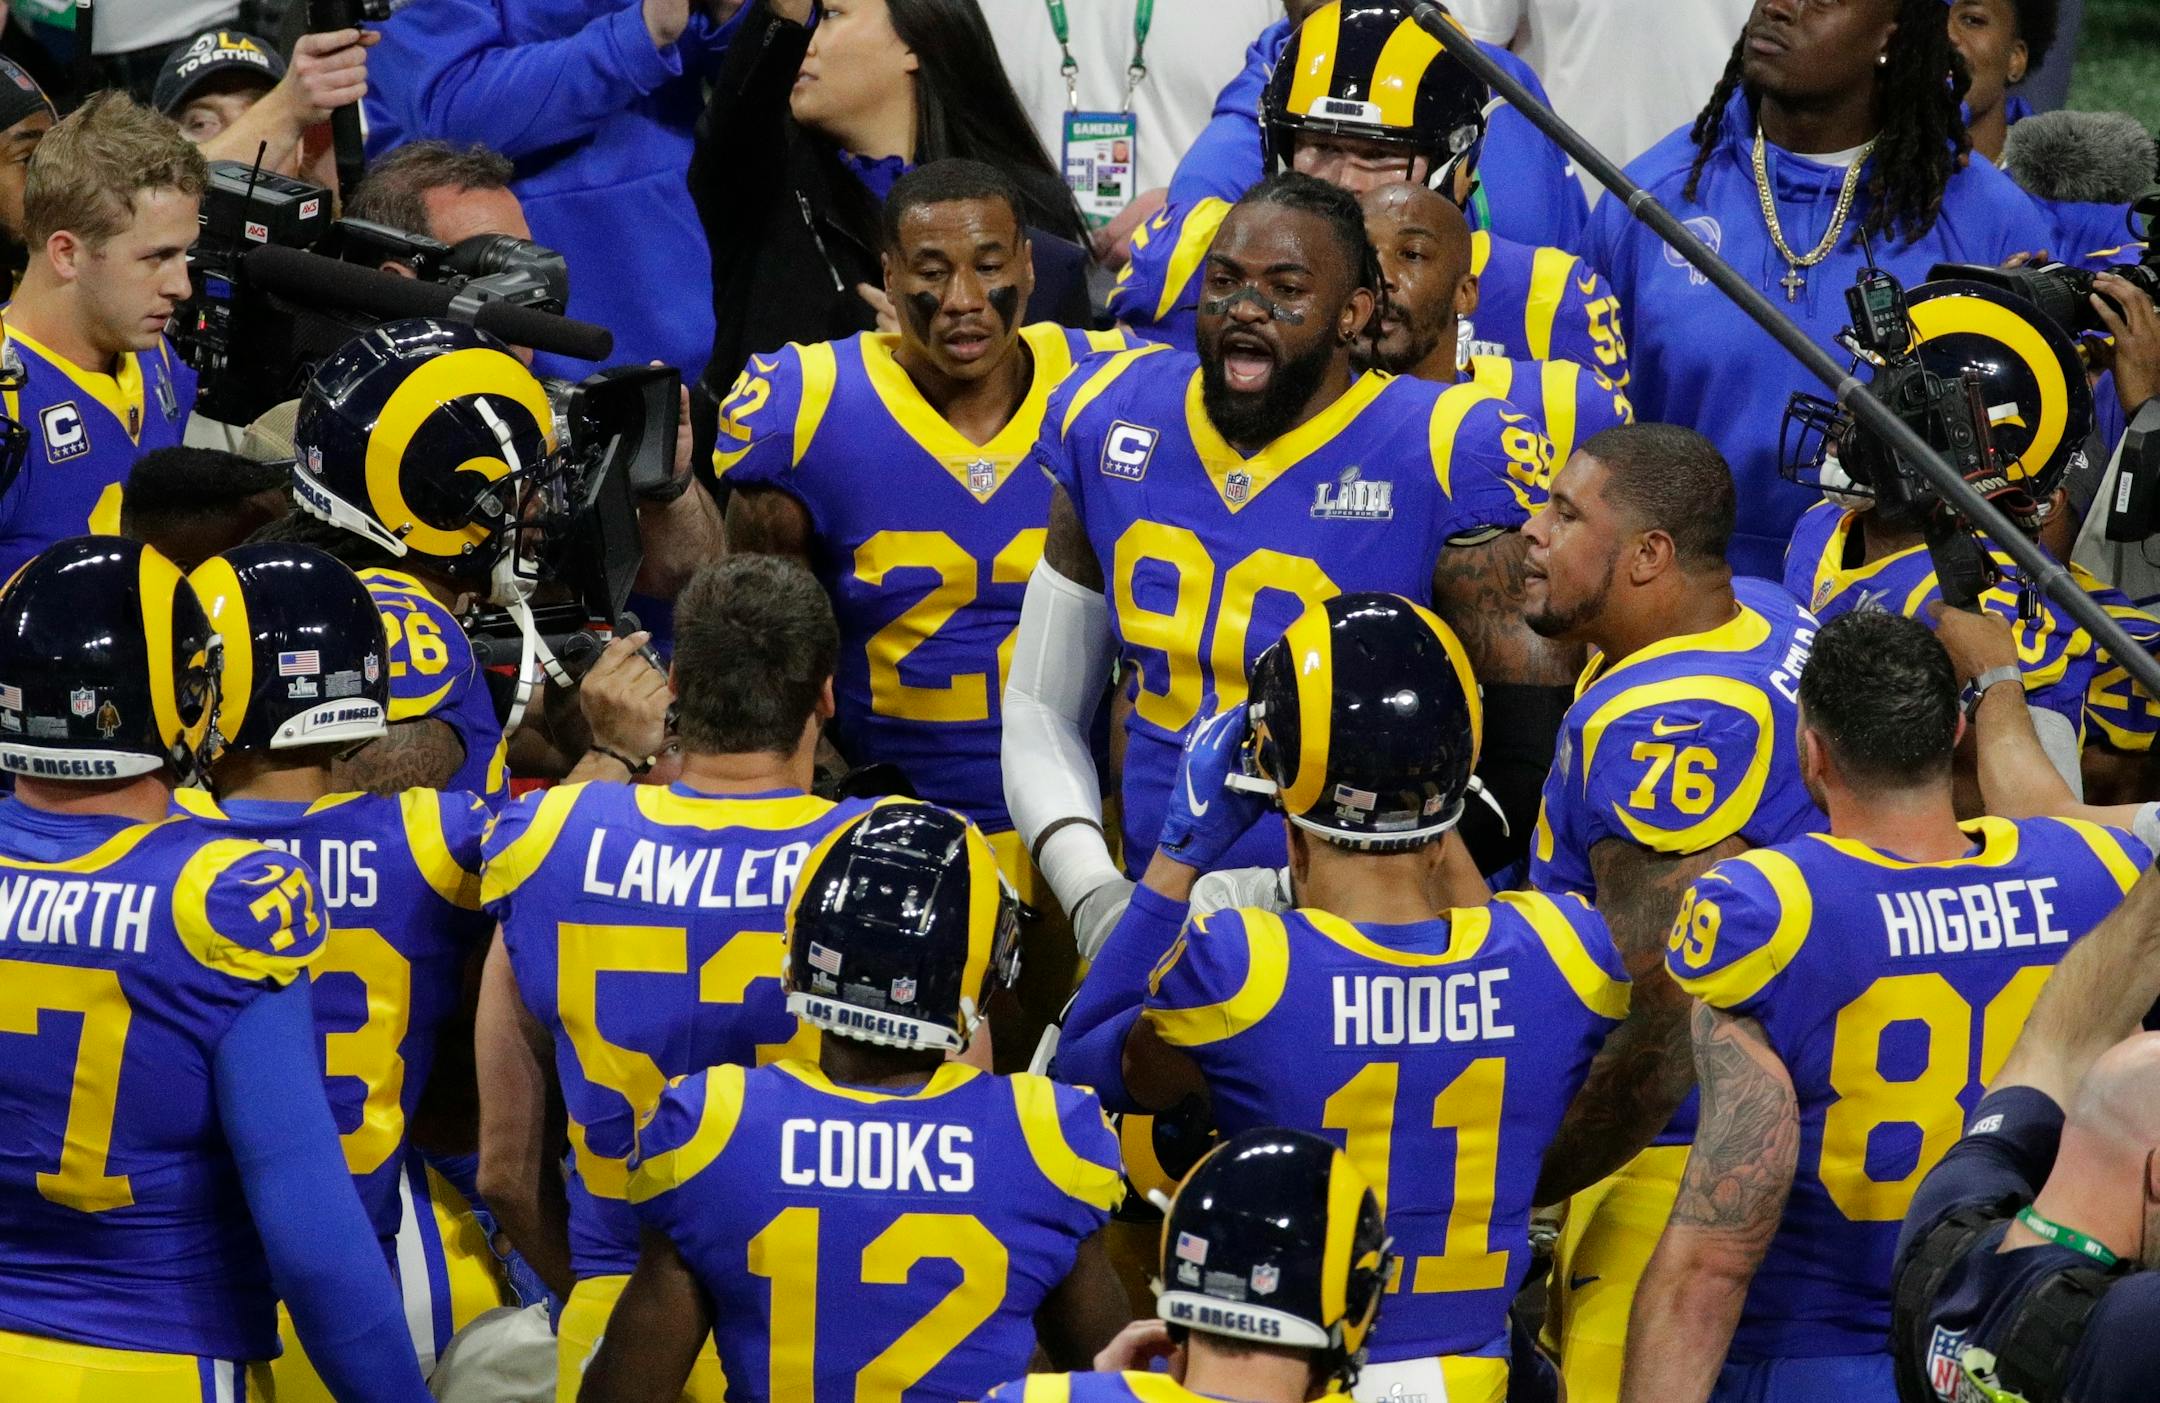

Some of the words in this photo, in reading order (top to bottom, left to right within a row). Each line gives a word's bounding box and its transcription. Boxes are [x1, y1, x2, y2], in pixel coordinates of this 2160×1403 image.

[176, 48, 270, 78] TOGETHER
[218, 32, 262, 53] LA
[1072, 122, 1128, 136] GAMEDAY
[1326, 101, 1364, 116] RAMS
[301, 201, 317, 214] AVS
[247, 225, 266, 238] AVS
[719, 369, 771, 442] 22
[45, 406, 83, 448] C
[1107, 425, 1152, 465] C
[1970, 475, 2009, 495] non
[313, 711, 335, 726] LOS
[2, 752, 28, 771] LOS
[32, 757, 117, 776] ANGELES
[1628, 741, 1719, 815] 76
[583, 827, 812, 909] LAWLER
[248, 867, 321, 952] 77
[1667, 885, 1722, 970] 89
[1876, 877, 2069, 957] HIGBEE
[806, 999, 833, 1021] LOS
[837, 1008, 919, 1041] ANGELES
[1332, 967, 1515, 1046] HODGE
[780, 1118, 975, 1193] COOKS
[1321, 1056, 1509, 1294] 11
[746, 1206, 1009, 1403] 12
[1170, 1301, 1194, 1320] LOS
[1199, 1306, 1281, 1338] ANGELES
